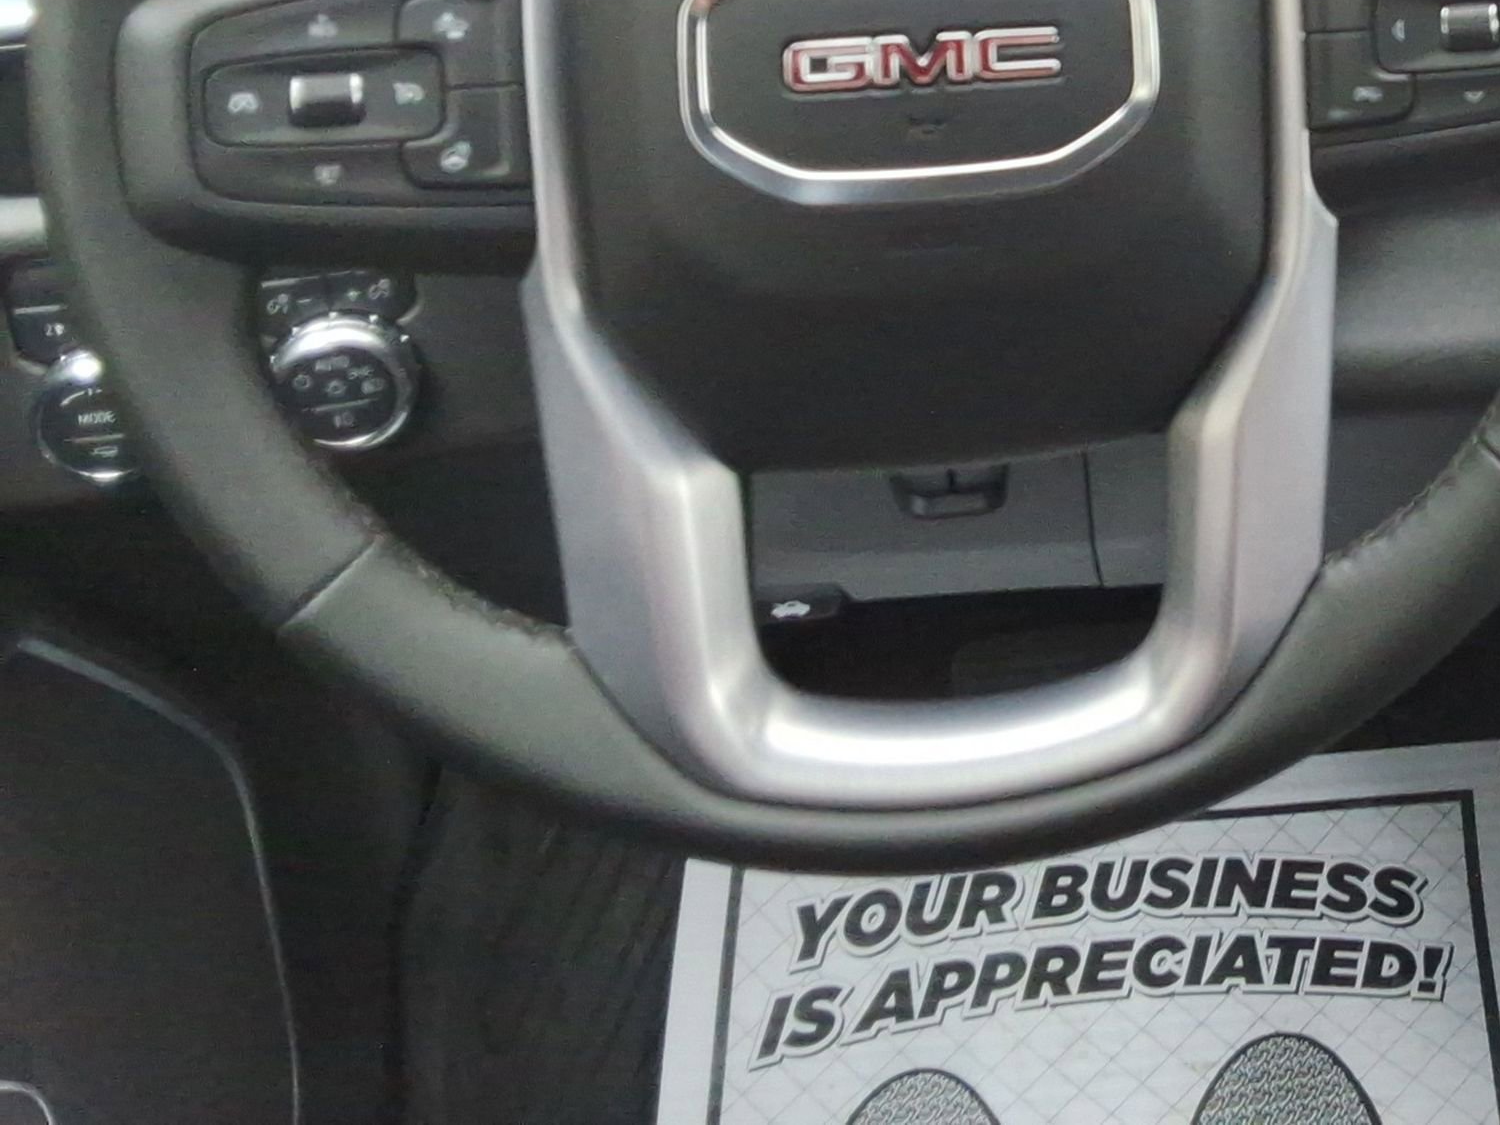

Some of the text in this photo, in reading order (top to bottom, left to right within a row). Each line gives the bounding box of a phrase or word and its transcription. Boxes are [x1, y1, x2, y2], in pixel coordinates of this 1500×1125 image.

[782, 26, 1061, 92] GMC
[797, 856, 1422, 960] YOUR BUSINESS
[758, 935, 1447, 1058] IS APPRECIATED!
